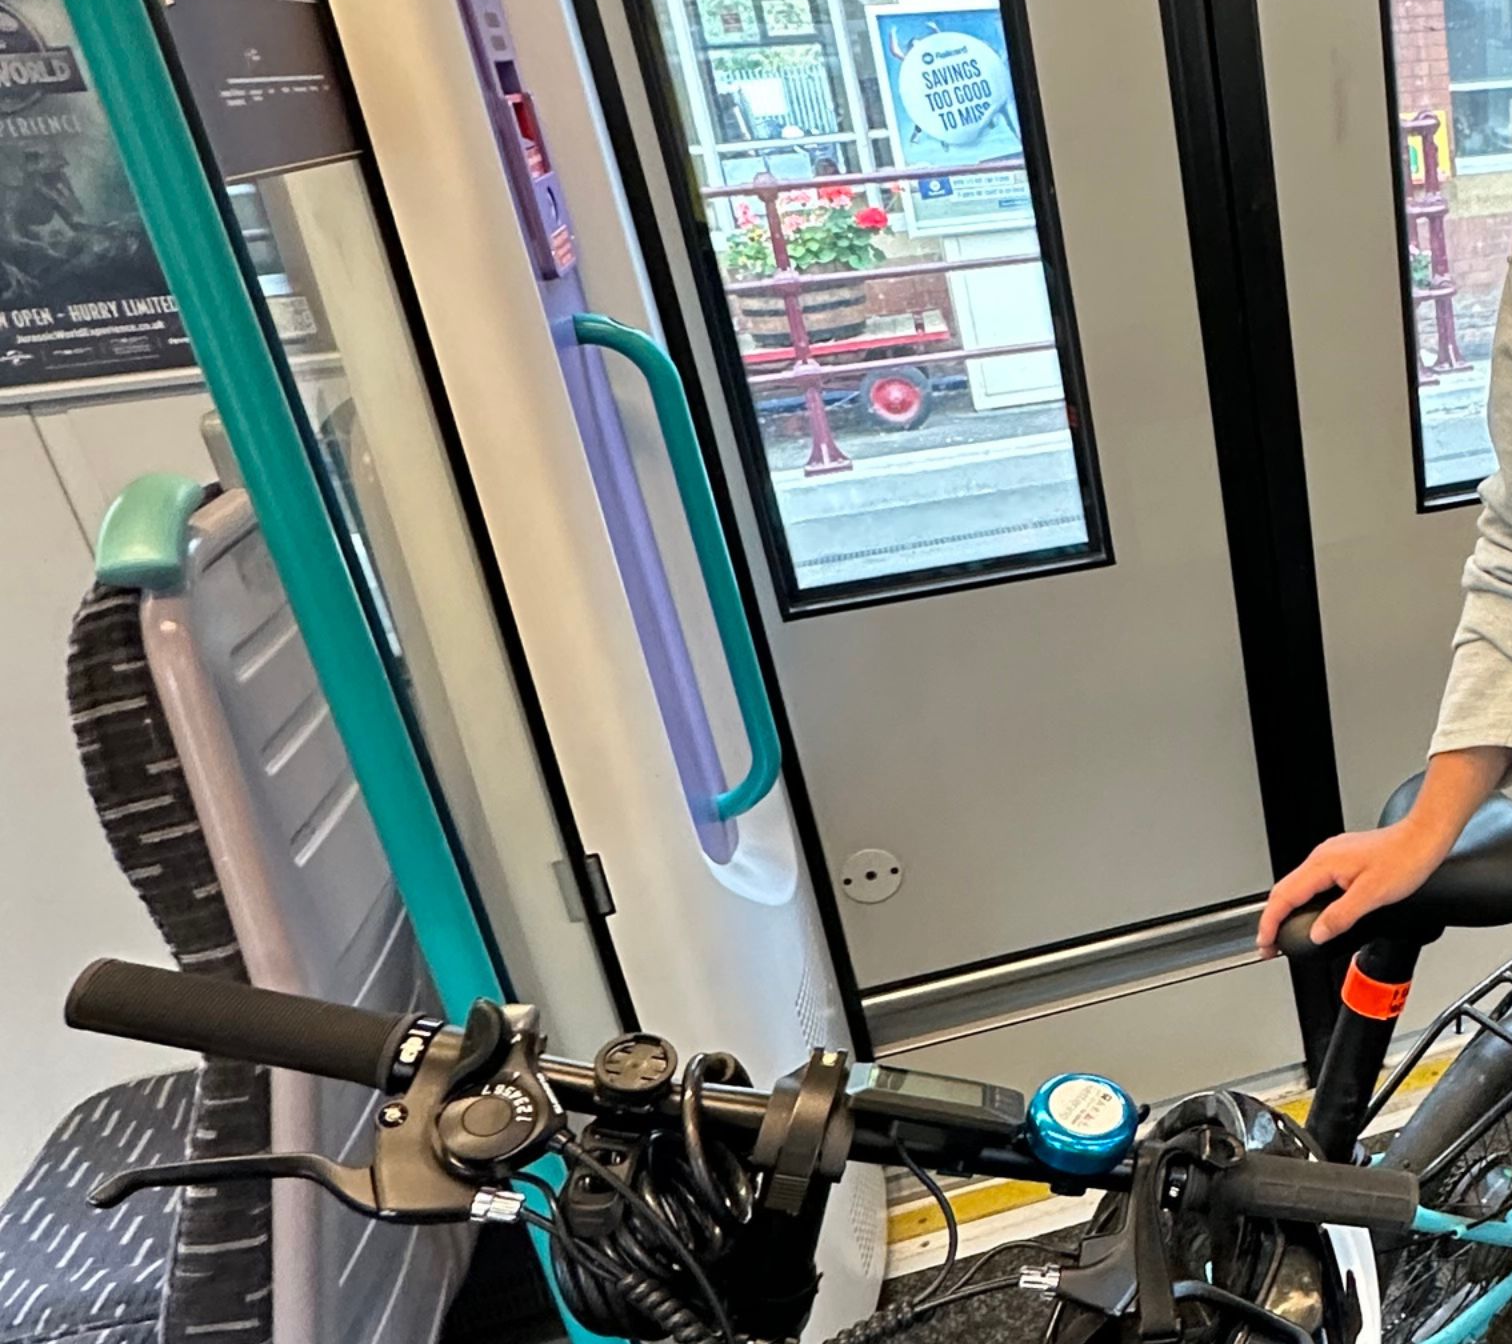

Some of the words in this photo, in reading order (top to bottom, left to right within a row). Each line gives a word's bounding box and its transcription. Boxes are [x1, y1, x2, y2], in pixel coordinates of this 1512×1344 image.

[922, 59, 981, 90] SAVINGS
[925, 89, 953, 112] TOO
[953, 80, 992, 104] GOOD
[938, 111, 957, 131] TO
[12, 307, 54, 328] OPEN
[68, 300, 119, 323] HURRY
